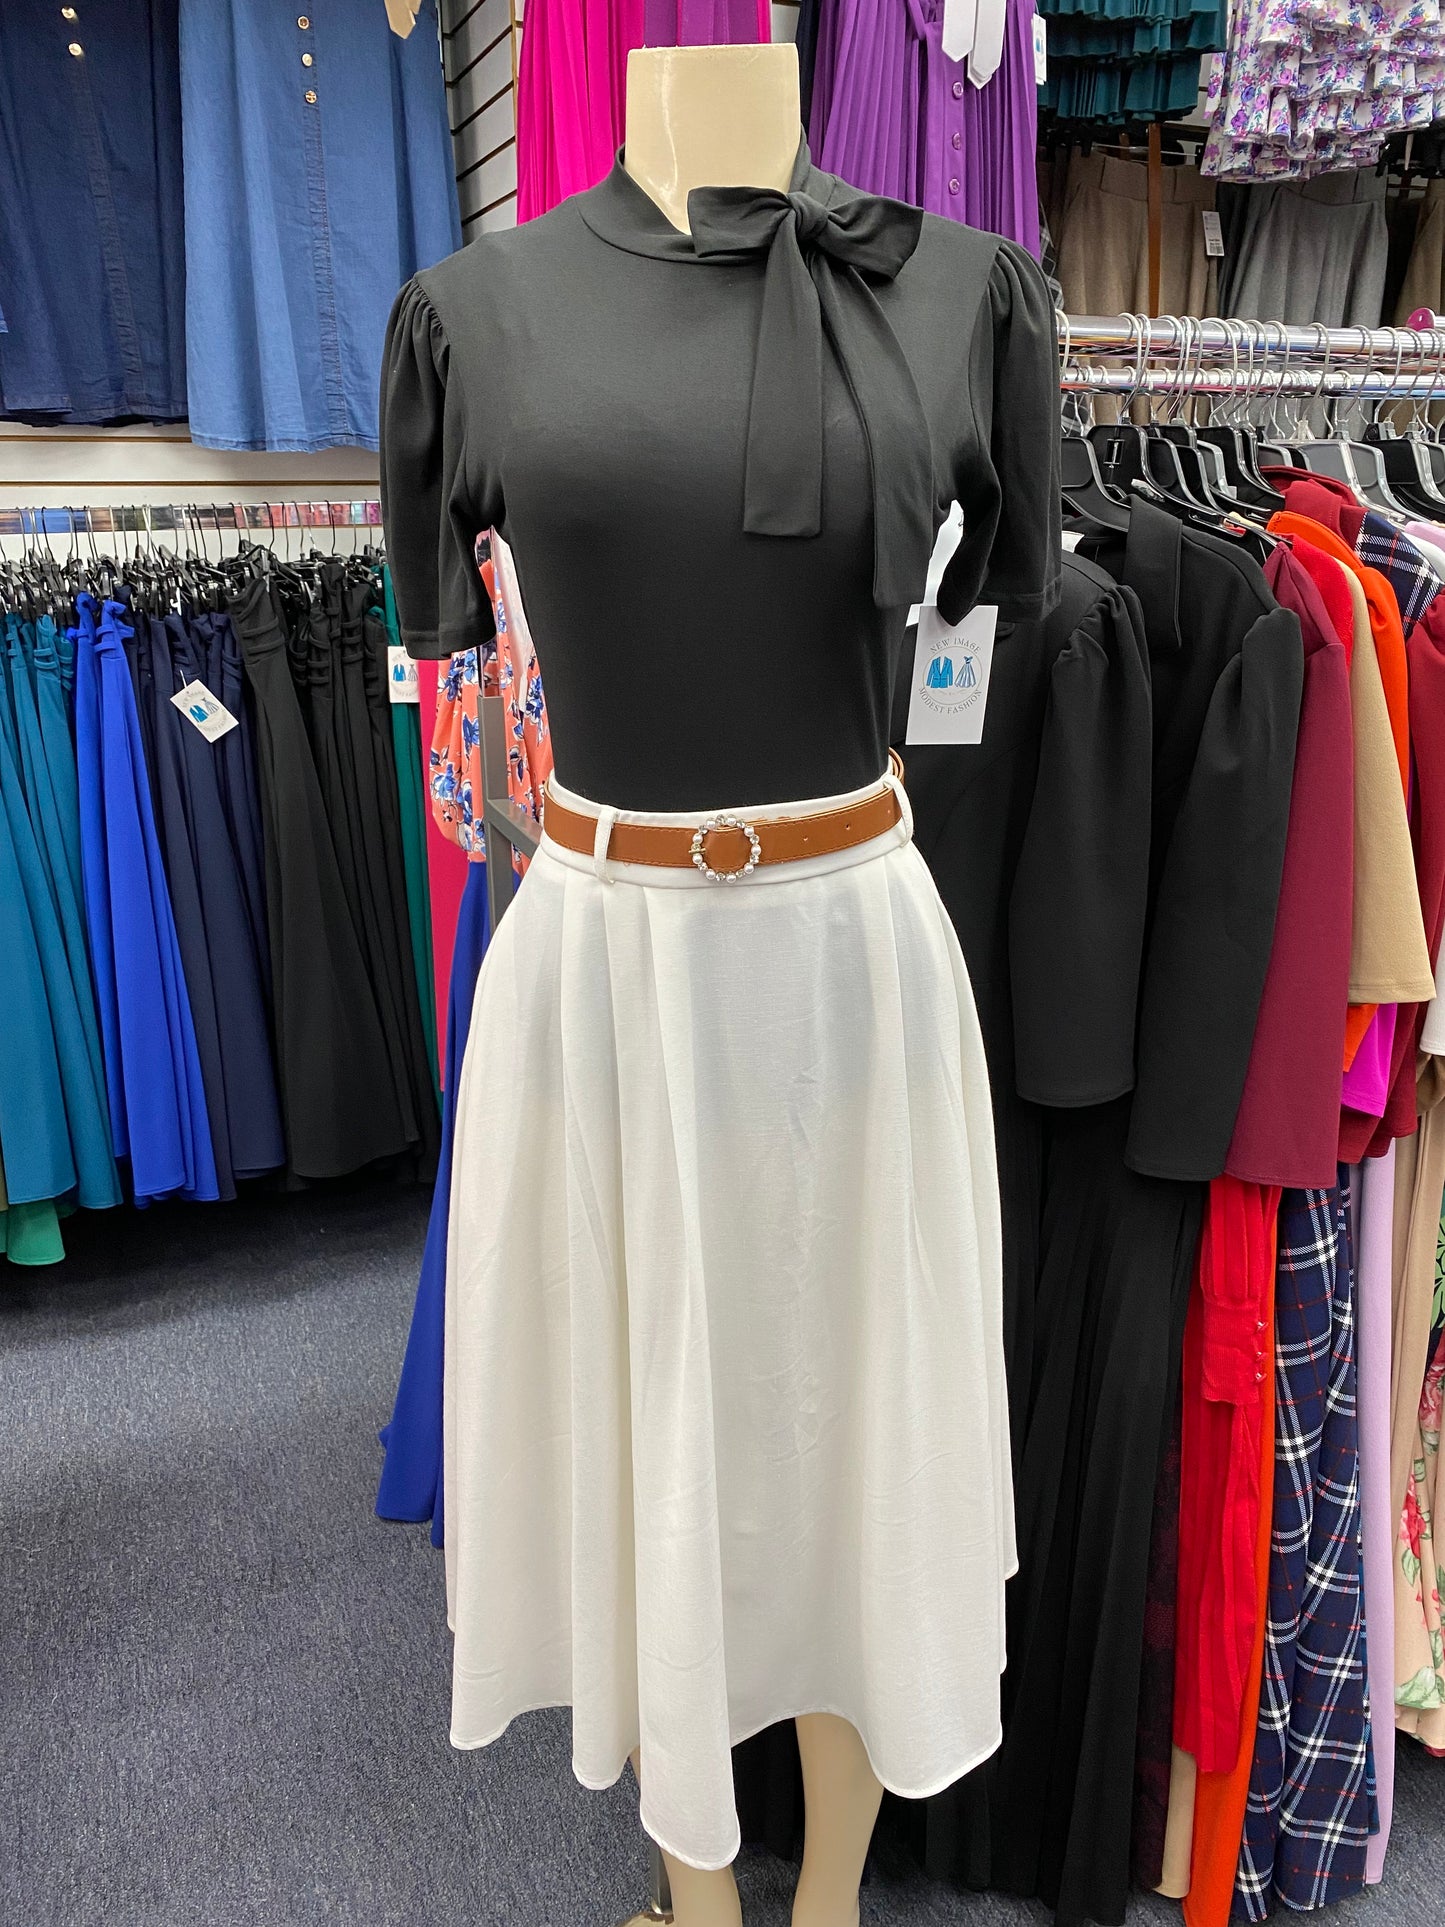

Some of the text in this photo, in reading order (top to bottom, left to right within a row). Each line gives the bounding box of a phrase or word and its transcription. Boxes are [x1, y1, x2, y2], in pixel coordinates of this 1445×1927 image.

[930, 637, 981, 654] NEW IMAGE
[919, 687, 982, 714] MODEST FASHION
